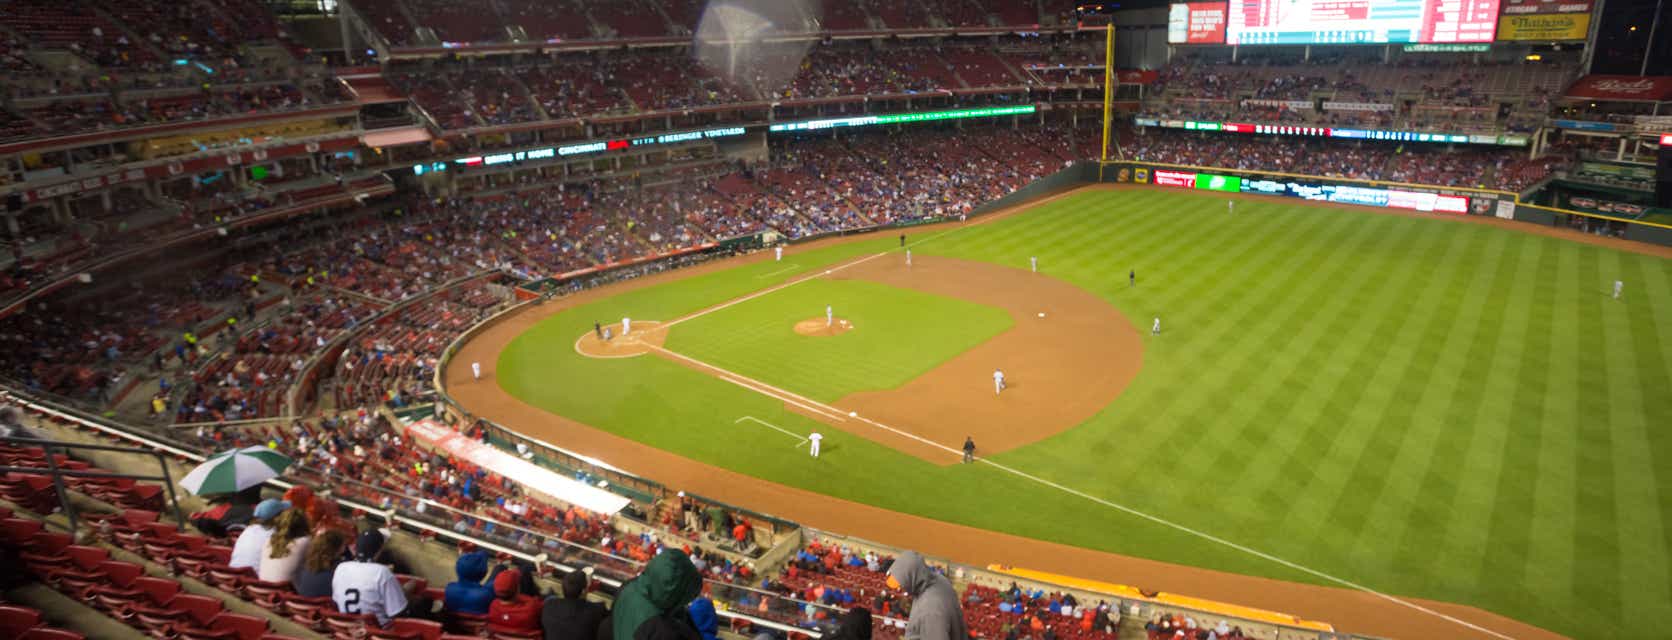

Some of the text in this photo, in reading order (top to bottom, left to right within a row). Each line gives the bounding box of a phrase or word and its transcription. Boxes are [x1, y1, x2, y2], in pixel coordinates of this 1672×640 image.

[704, 127, 745, 138] VINEYARDS
[484, 153, 513, 165] BRING
[516, 151, 525, 161] IT
[528, 148, 554, 159] HOME
[558, 142, 607, 156] CINCINNATI
[345, 588, 361, 613] 2
